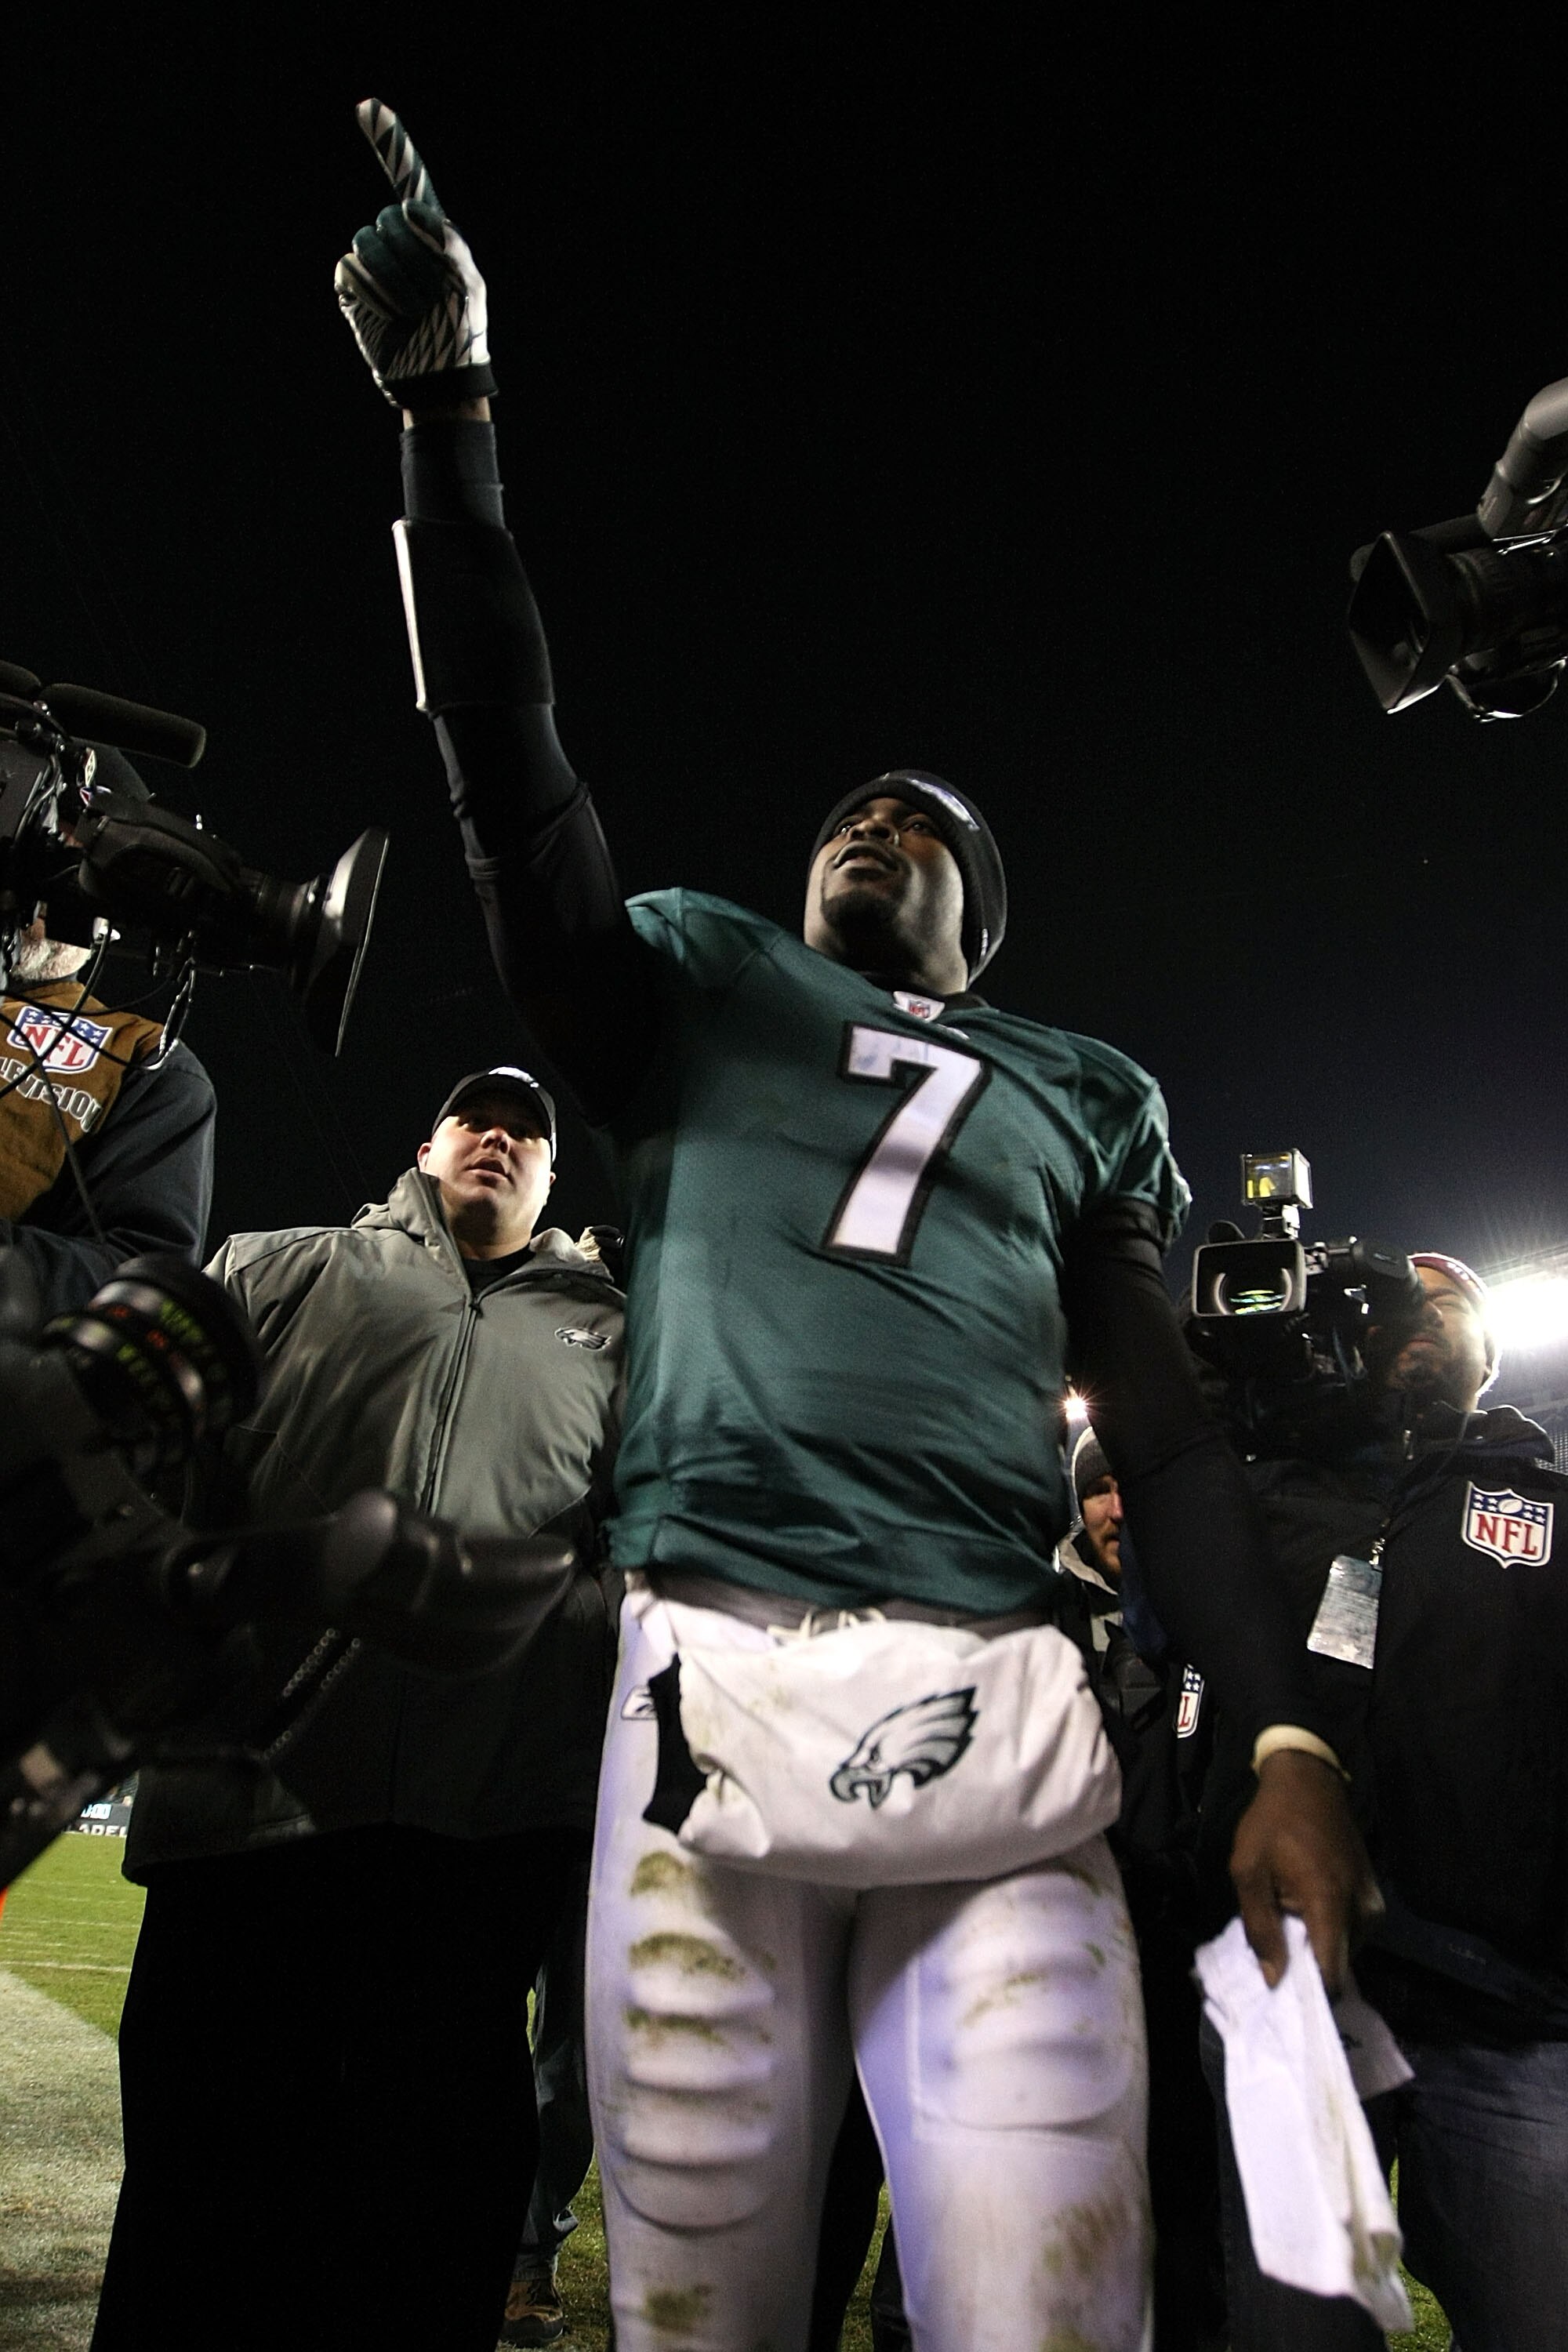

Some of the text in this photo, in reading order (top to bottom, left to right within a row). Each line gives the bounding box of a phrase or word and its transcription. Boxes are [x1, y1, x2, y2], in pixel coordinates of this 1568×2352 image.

[19, 1025, 85, 1066] NFL
[822, 1022, 992, 1267] 7
[1475, 1513, 1538, 1556] NFL
